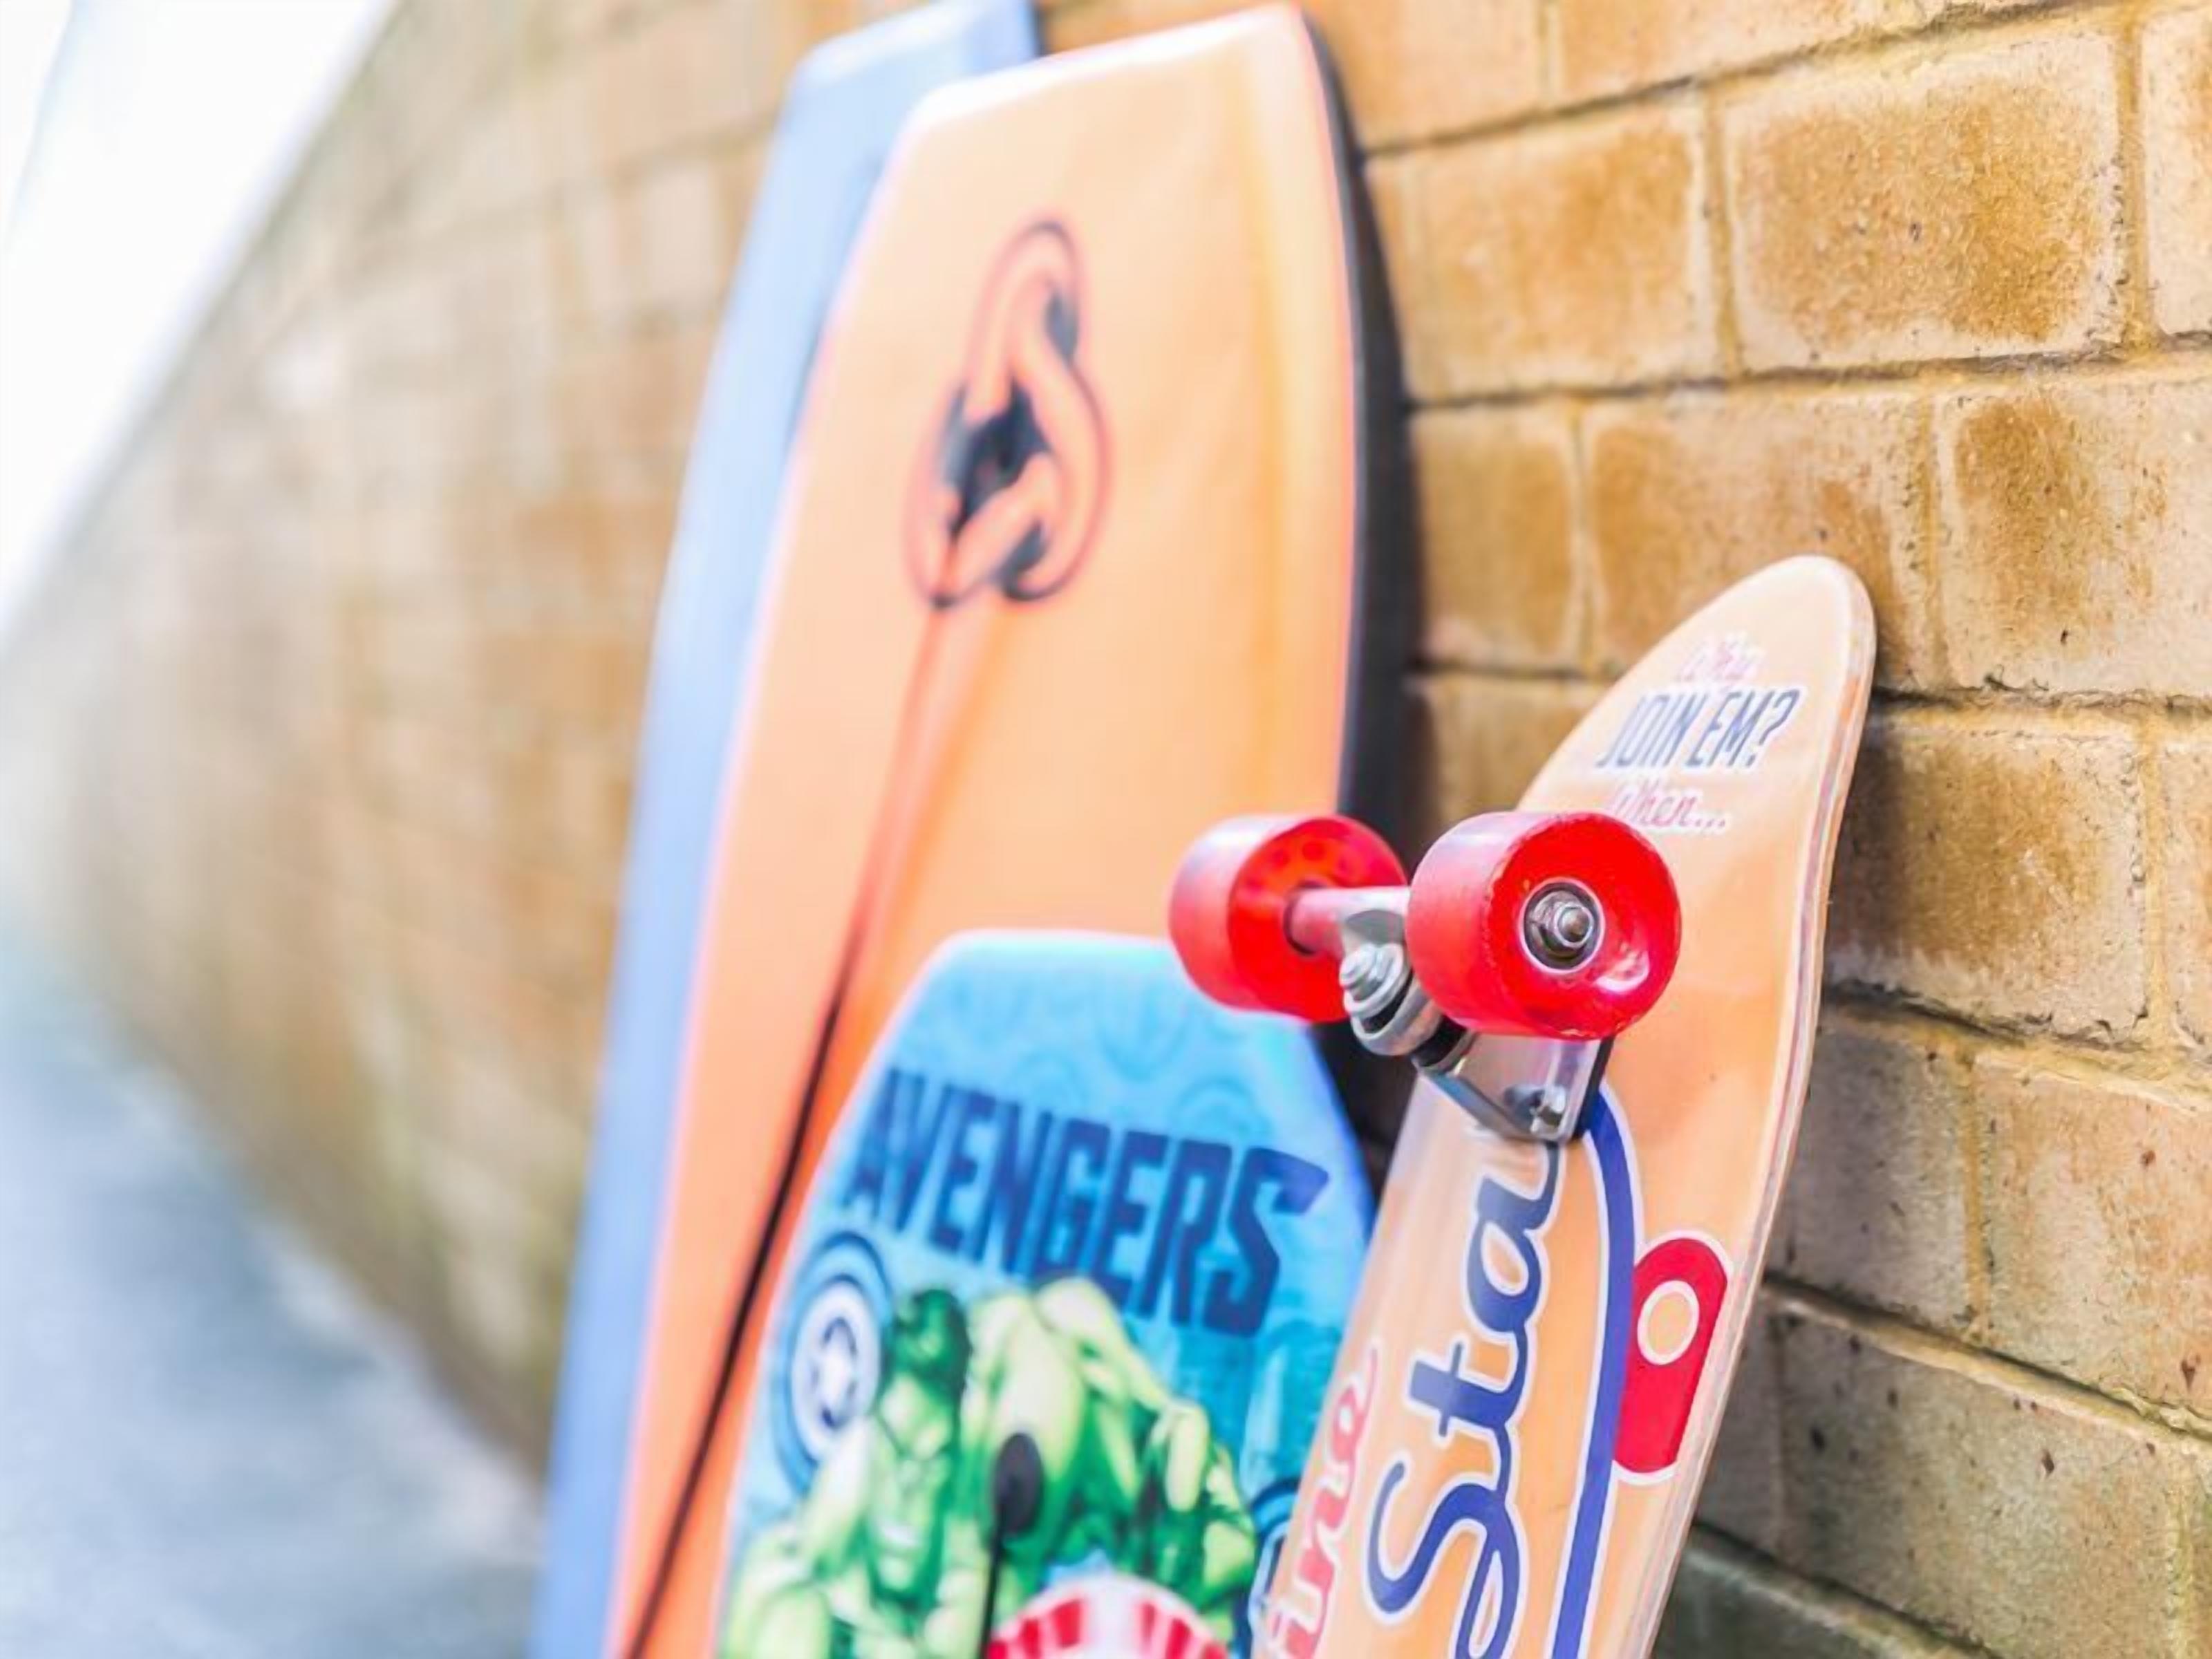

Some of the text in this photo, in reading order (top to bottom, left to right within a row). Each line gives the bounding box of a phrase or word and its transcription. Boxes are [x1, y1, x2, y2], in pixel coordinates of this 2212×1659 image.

[1595, 688, 1800, 768] JOIN EM?
[840, 1067, 1329, 1338] AVENGERS
